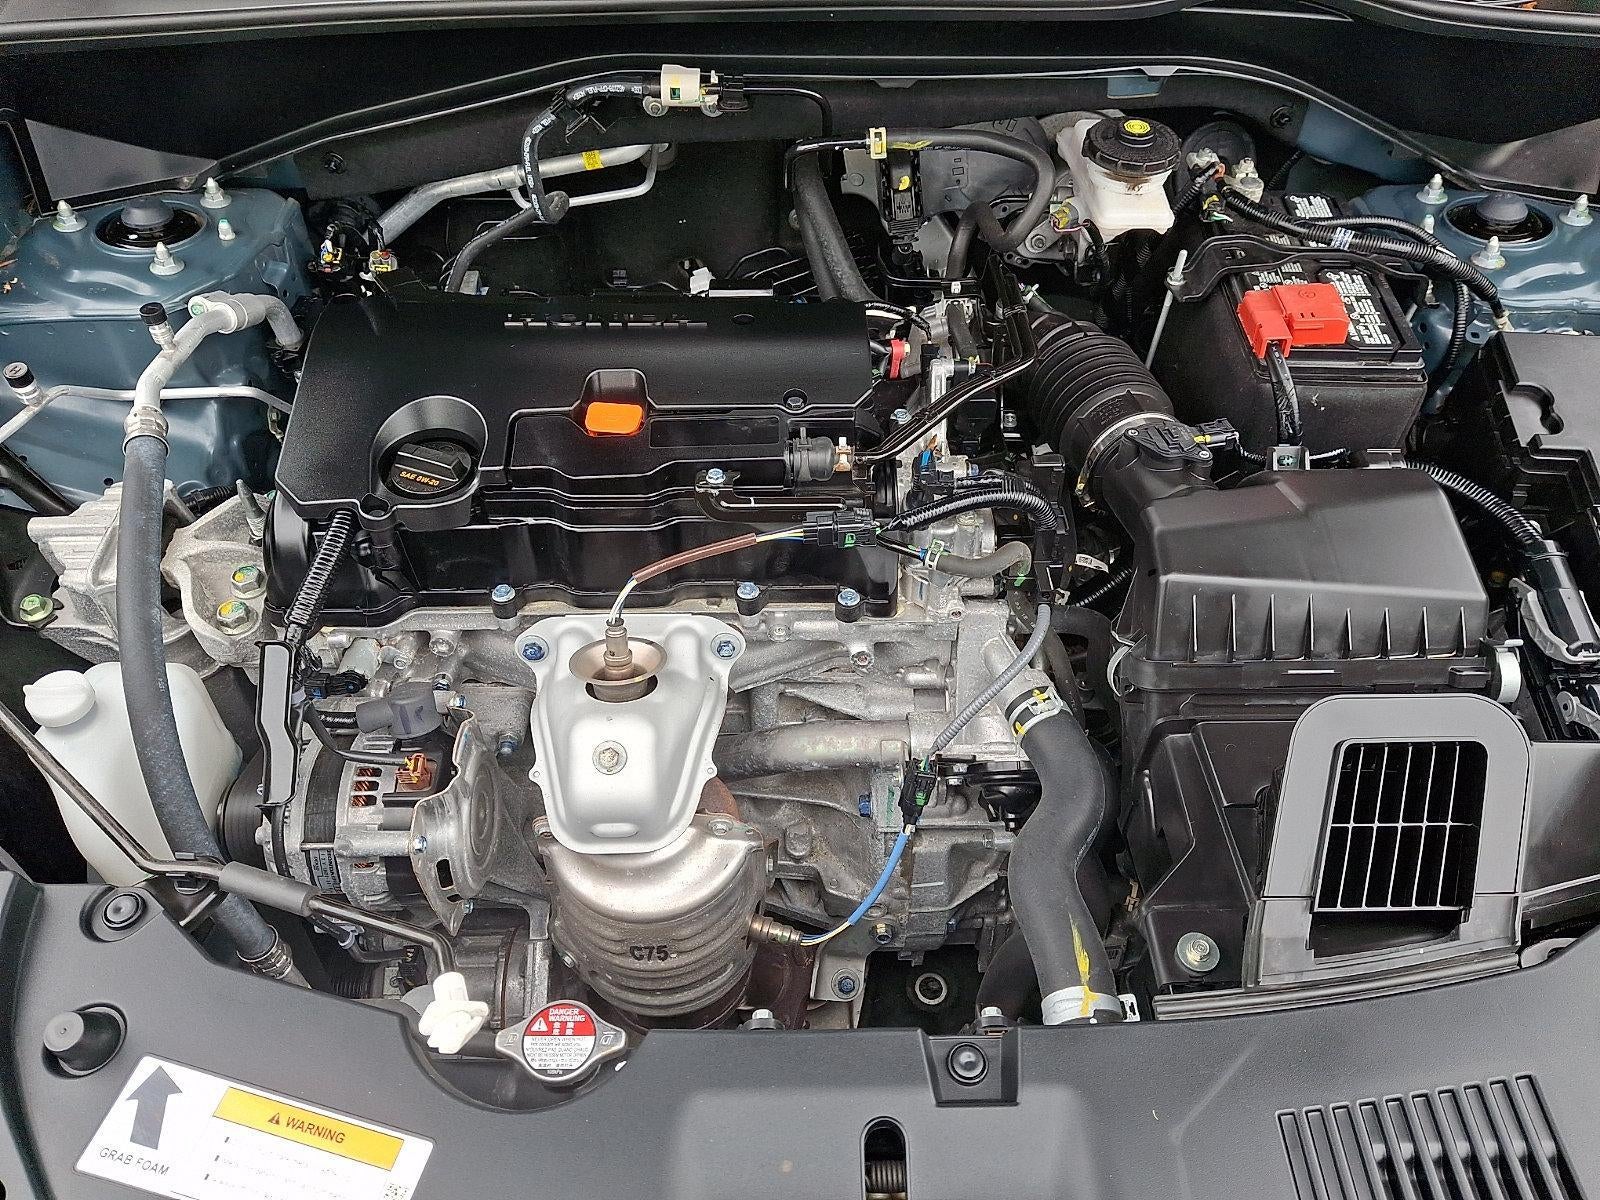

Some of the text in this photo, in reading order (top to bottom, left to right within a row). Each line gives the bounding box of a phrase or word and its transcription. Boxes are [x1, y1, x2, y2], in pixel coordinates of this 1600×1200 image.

[399, 471, 440, 486] SAE 0W-20
[629, 945, 669, 961] C75
[286, 1116, 345, 1145] WARNING
[99, 1147, 170, 1176] GRAB FOAM
